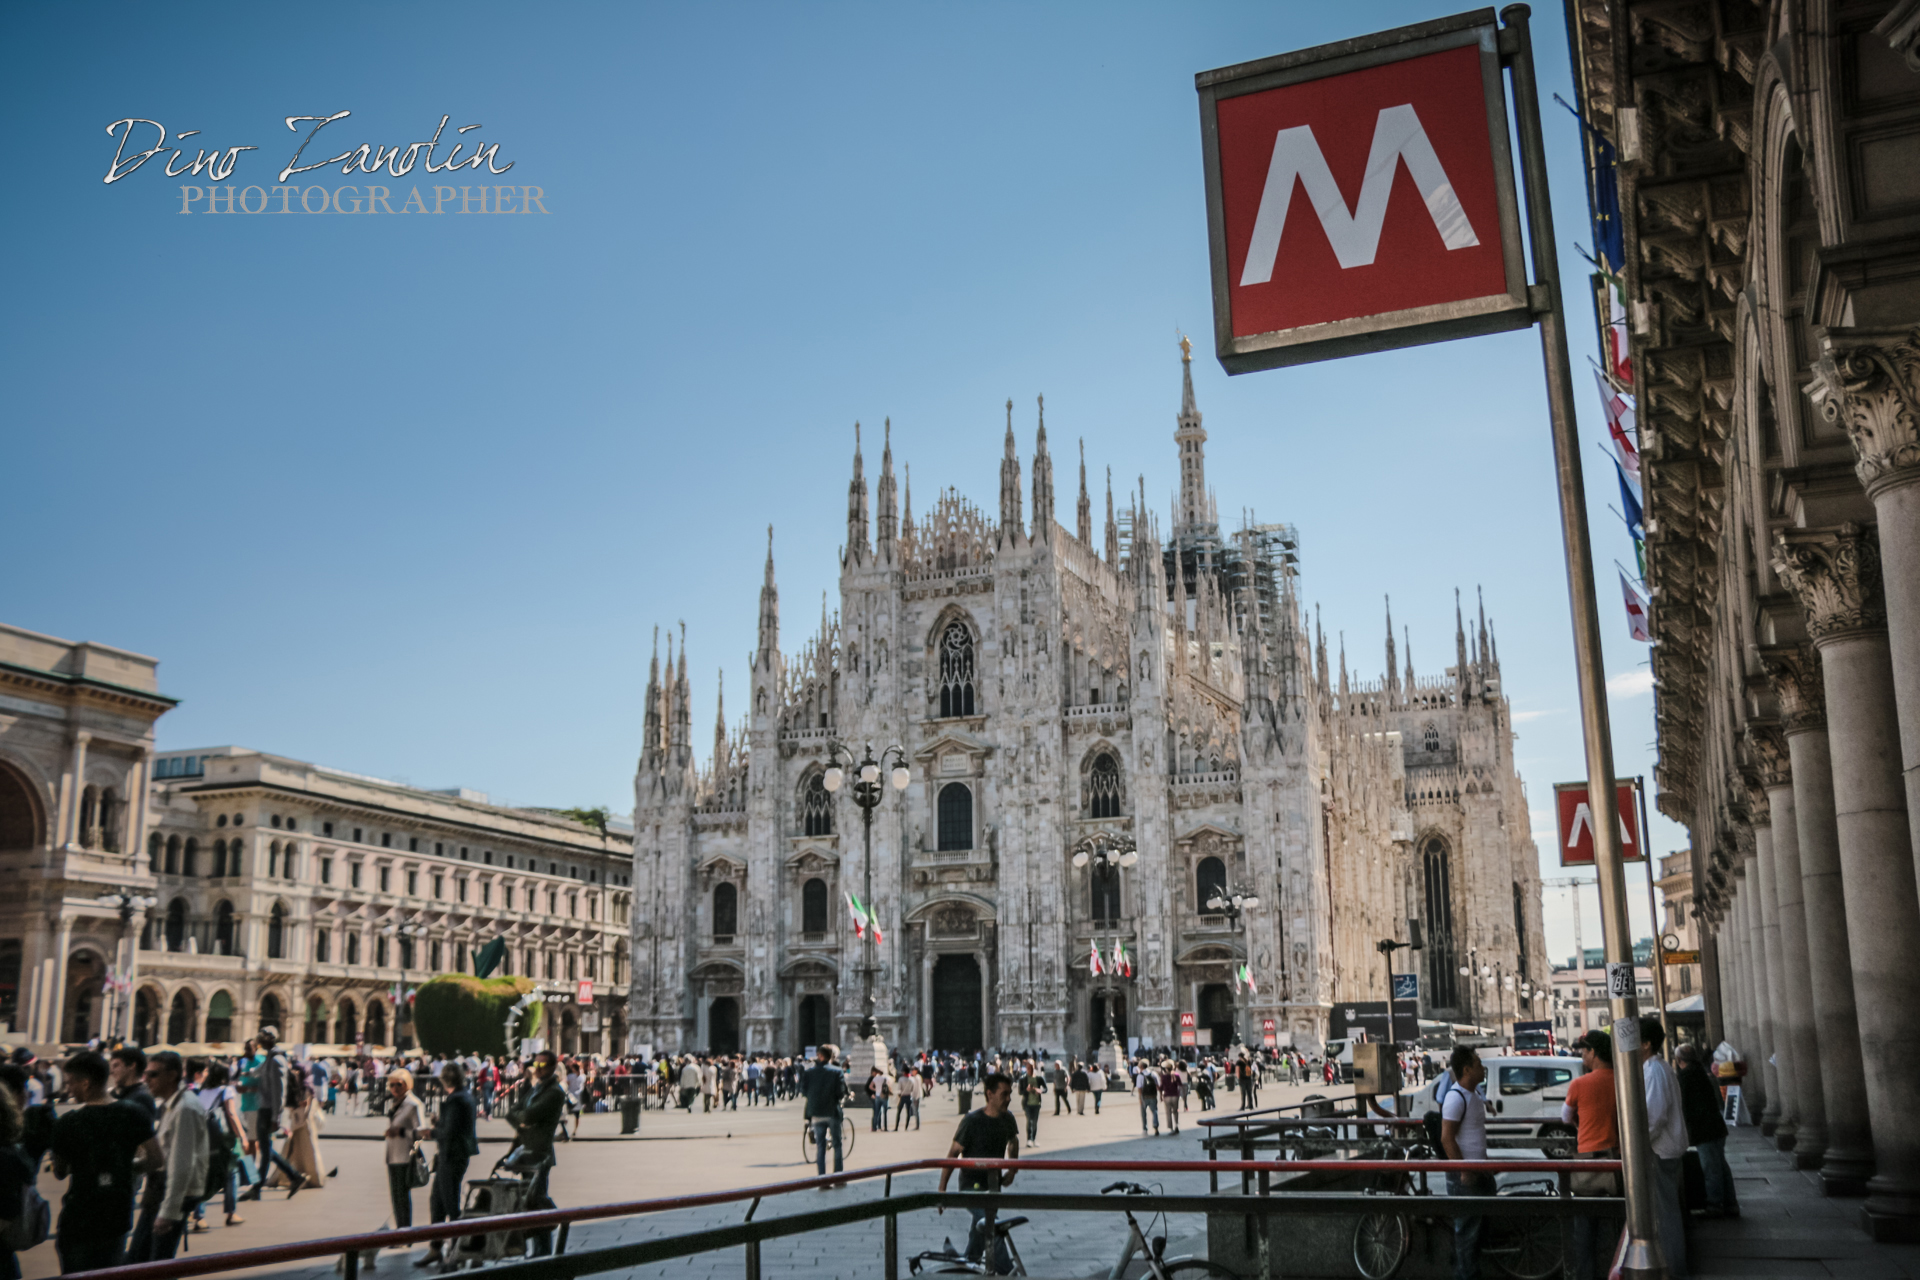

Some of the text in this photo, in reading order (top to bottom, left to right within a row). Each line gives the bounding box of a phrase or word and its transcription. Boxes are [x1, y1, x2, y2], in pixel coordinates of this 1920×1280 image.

[1239, 103, 1480, 286] M
[578, 984, 592, 999] M
[1181, 1015, 1194, 1025] M
[1264, 1021, 1274, 1029] M
